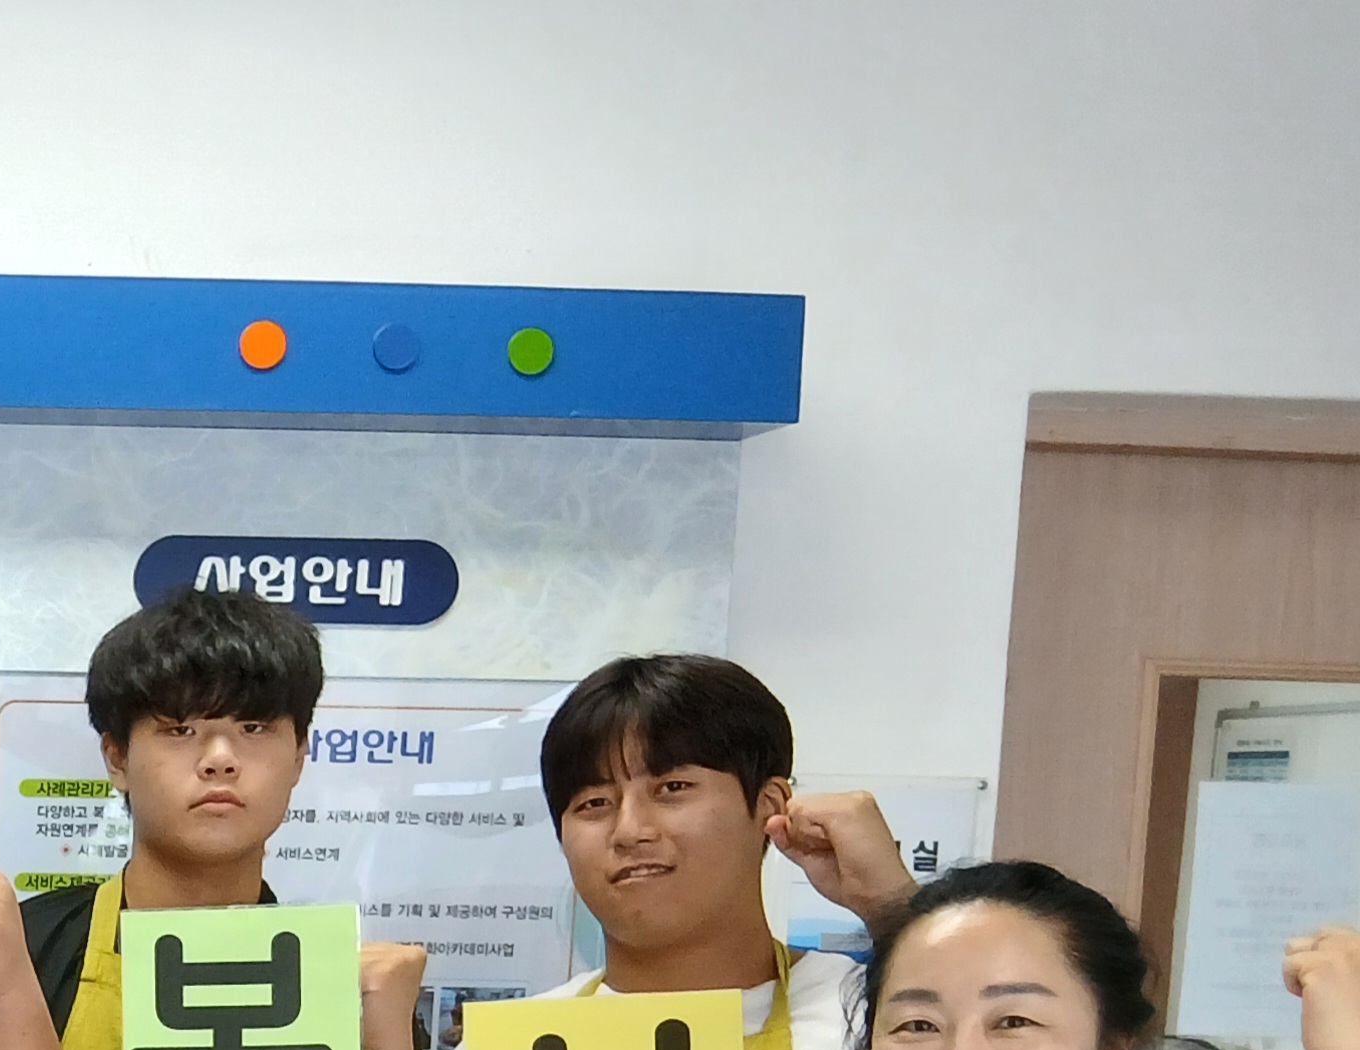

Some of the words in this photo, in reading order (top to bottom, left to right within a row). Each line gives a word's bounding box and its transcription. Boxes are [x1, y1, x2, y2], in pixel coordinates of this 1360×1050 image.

[193, 555, 405, 606] 사업안내
[36, 781, 117, 798] 사례관리기
[37, 805, 88, 820] 다양하고
[326, 810, 390, 824] 지역사회에
[395, 811, 421, 825] 있는
[425, 811, 464, 826] 다양한
[468, 812, 507, 827] 서비스
[512, 812, 526, 827] 및
[275, 847, 341, 862] 서비스연계
[397, 904, 423, 918] 기획
[428, 904, 441, 919] 및
[446, 905, 497, 919] 제공하여
[501, 905, 554, 920] 구성원의
